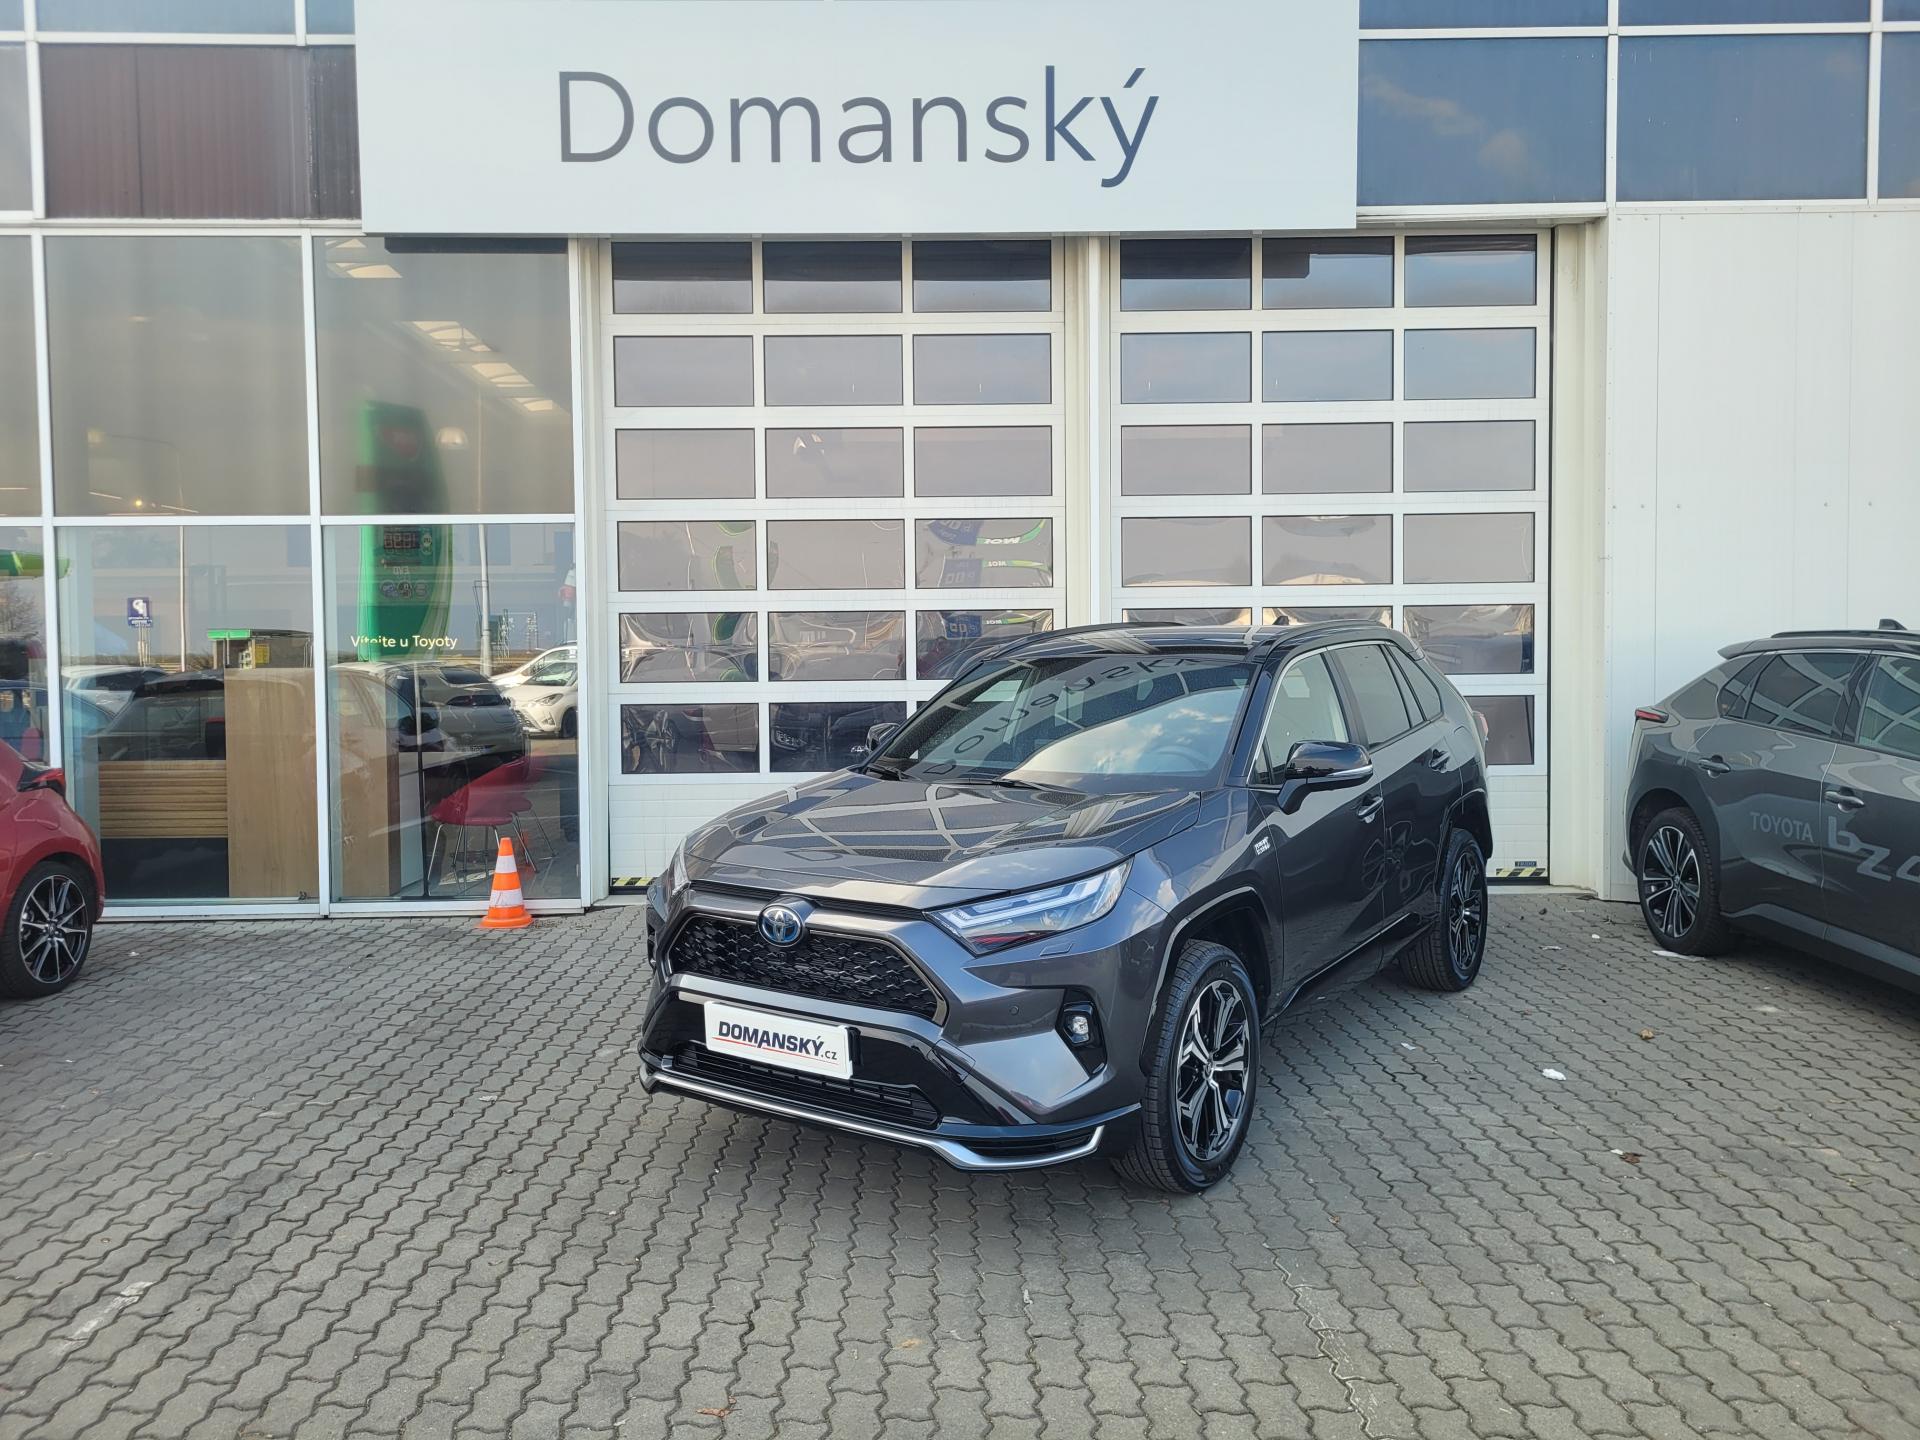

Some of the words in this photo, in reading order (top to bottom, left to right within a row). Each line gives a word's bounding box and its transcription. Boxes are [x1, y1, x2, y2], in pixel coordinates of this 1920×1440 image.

[559, 65, 1160, 188] Domanský
[400, 638, 409, 648] u
[412, 635, 458, 650] Toyoty
[1750, 811, 1814, 843] TOYOTA
